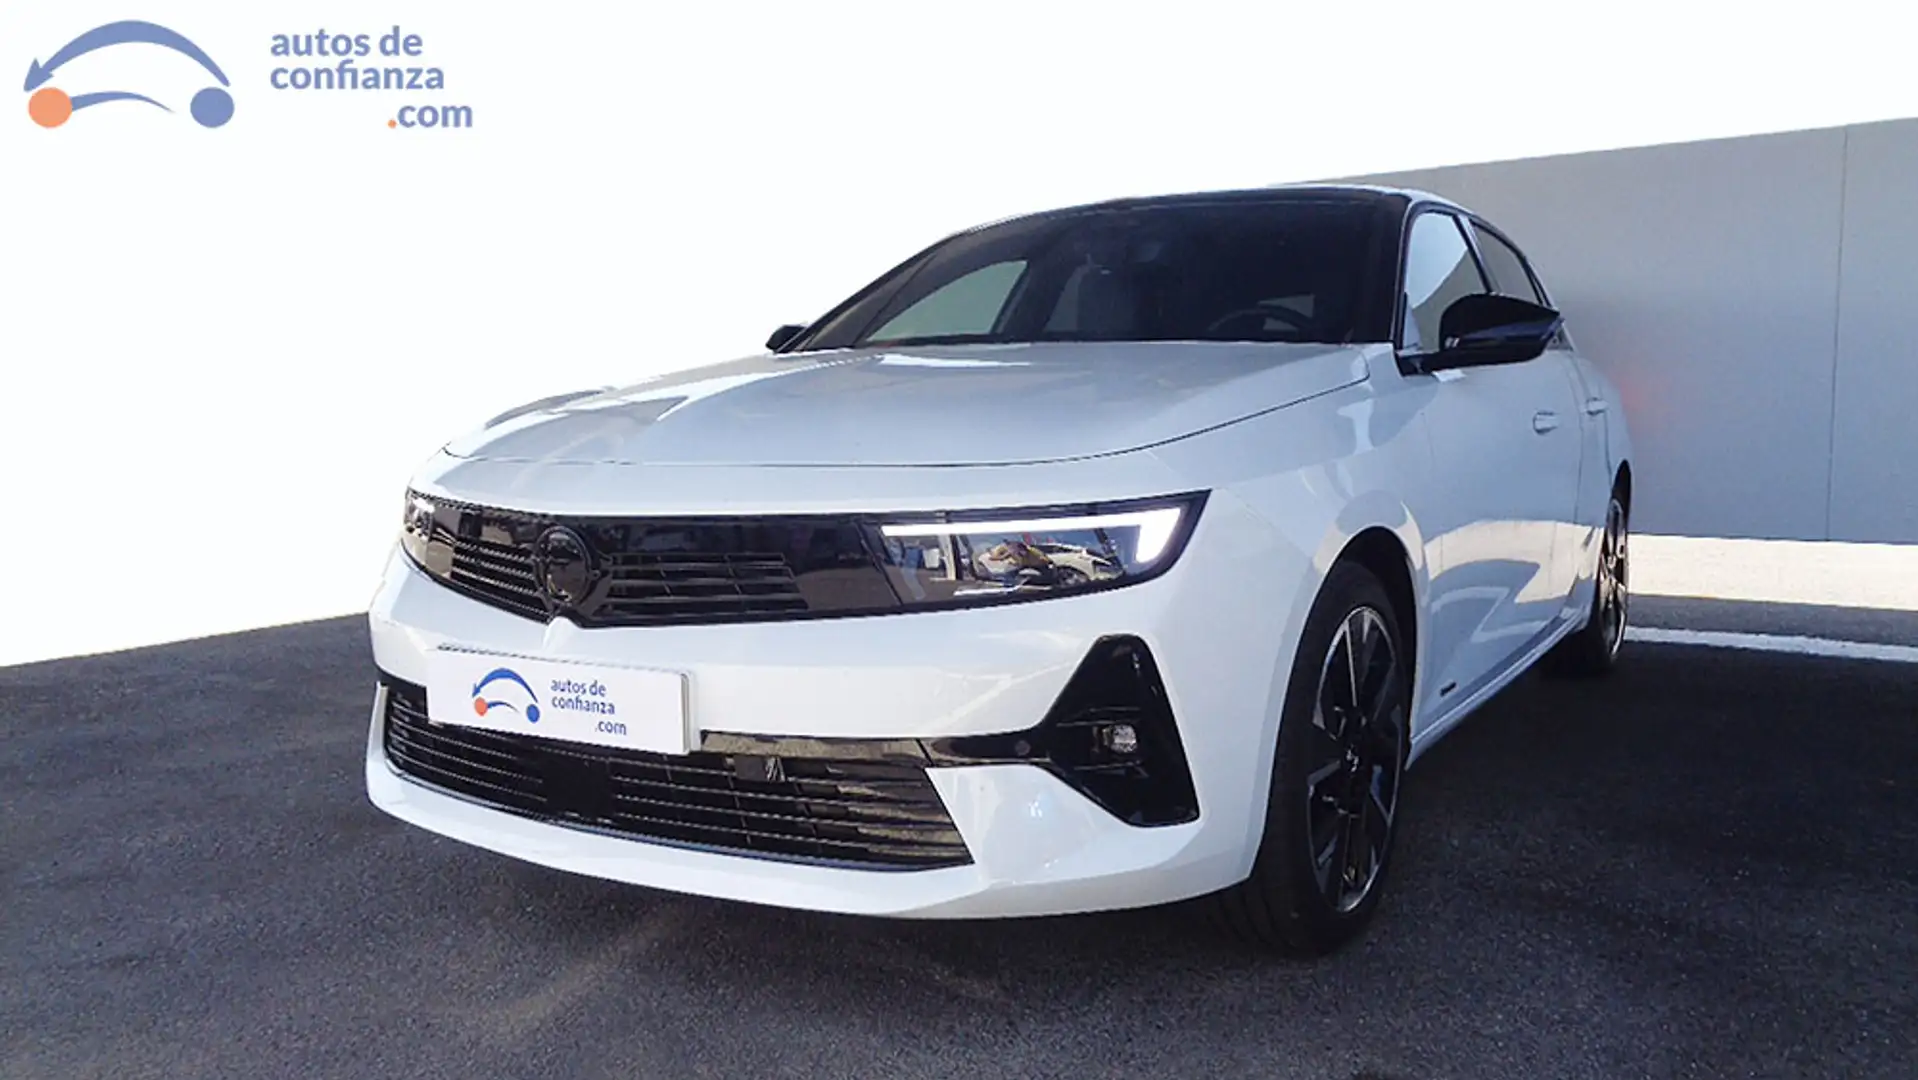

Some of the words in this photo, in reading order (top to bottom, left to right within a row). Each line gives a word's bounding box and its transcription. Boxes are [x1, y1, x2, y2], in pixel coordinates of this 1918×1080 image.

[550, 679, 587, 695] autos
[588, 679, 606, 697] de
[551, 696, 615, 715] confianza
